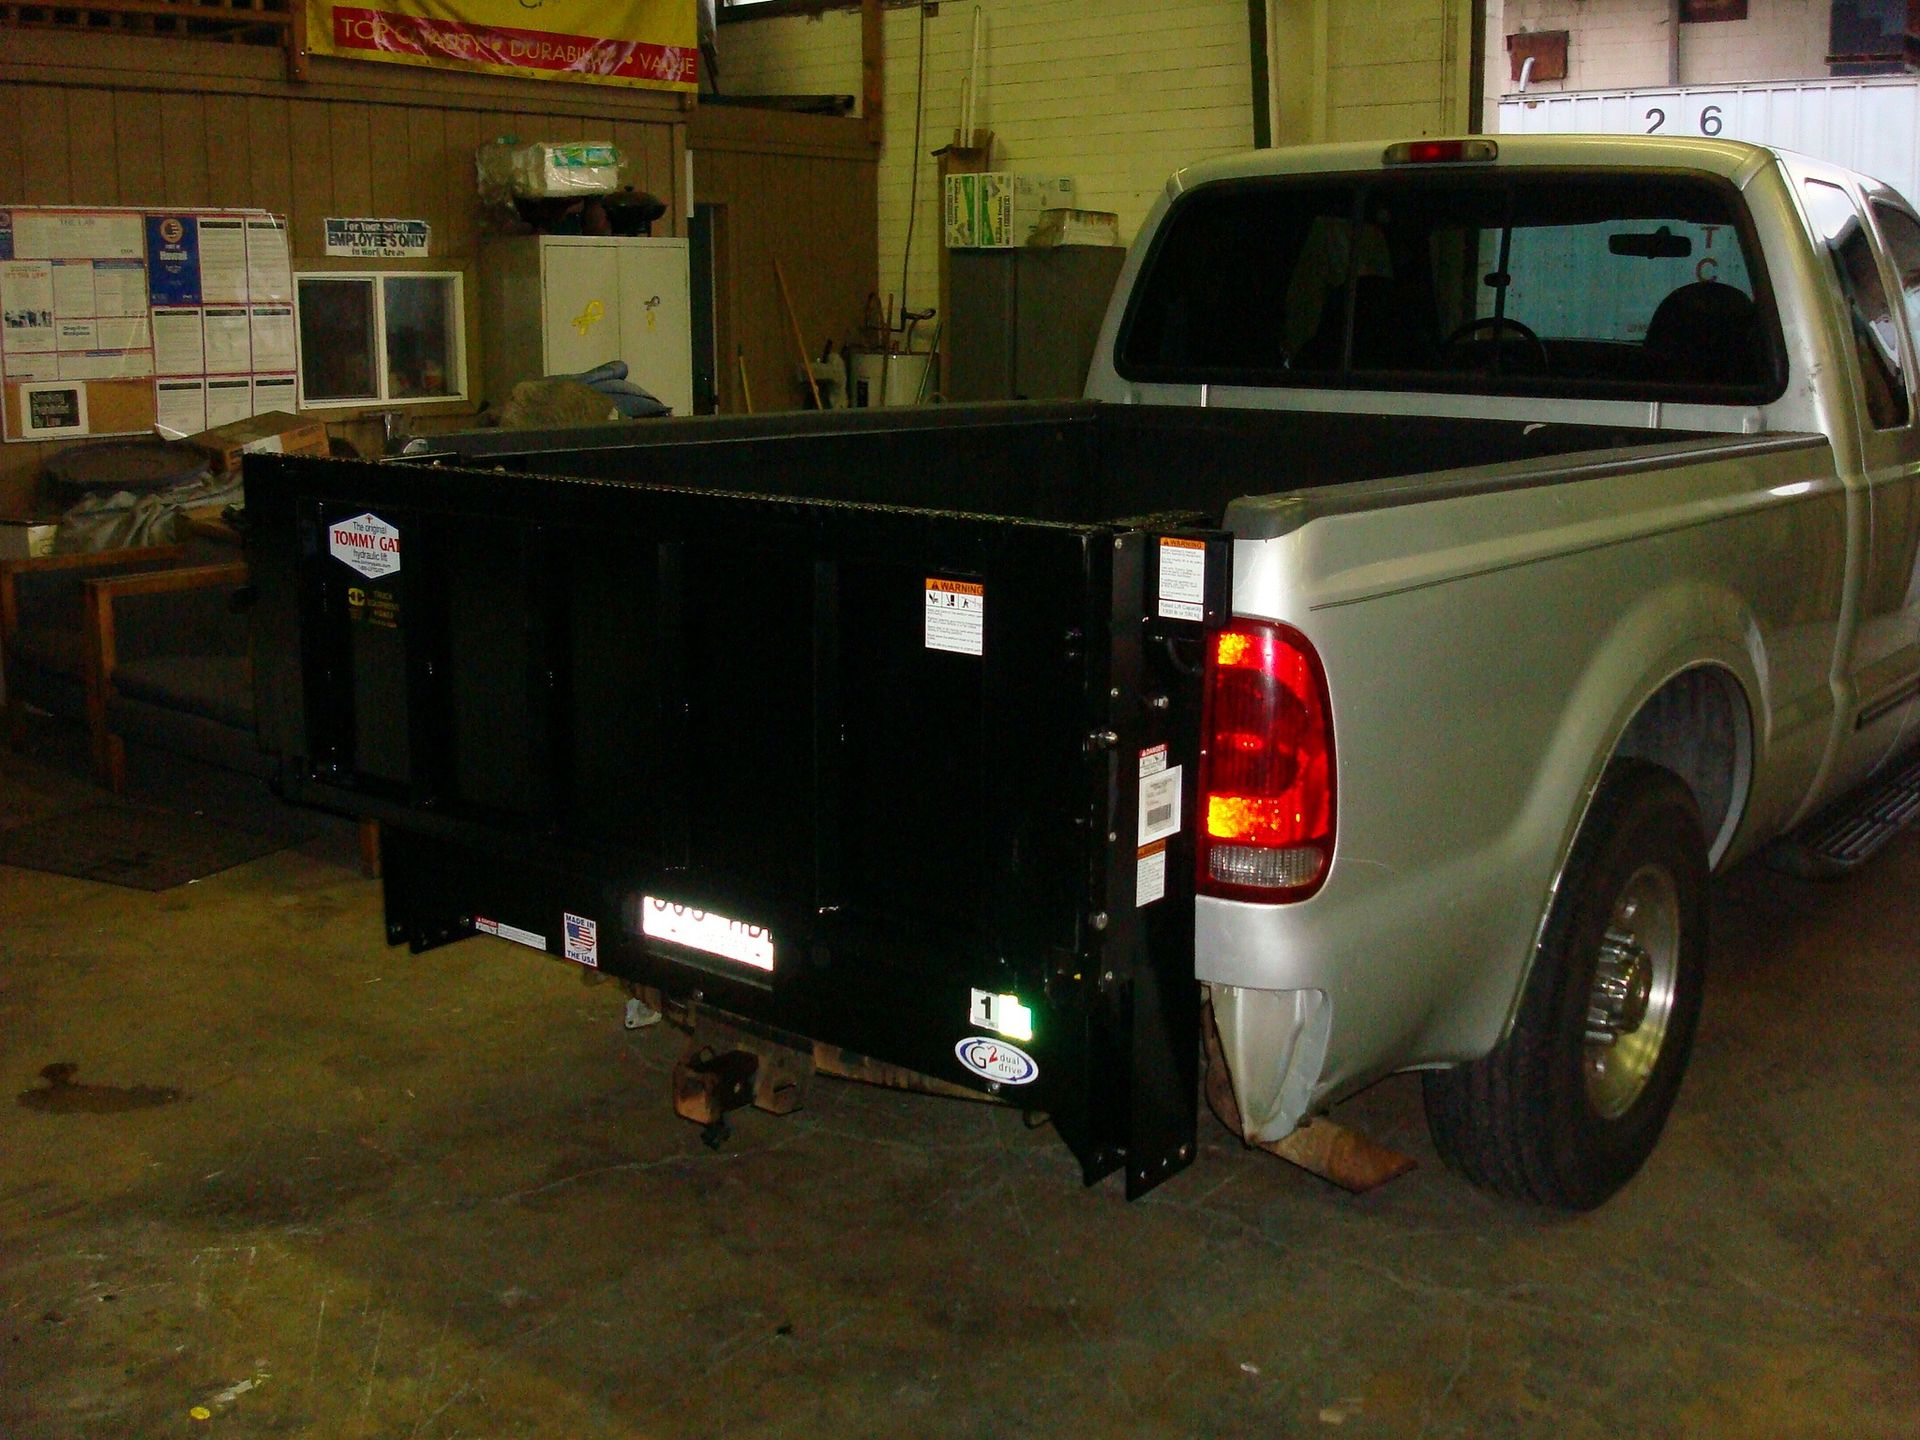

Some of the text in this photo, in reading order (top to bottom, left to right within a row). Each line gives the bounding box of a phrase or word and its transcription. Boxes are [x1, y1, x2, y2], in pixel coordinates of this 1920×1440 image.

[340, 18, 388, 41] TOP
[510, 38, 616, 69] DURABIL
[640, 53, 695, 75] VALUE
[1645, 105, 1723, 137] 2 6
[344, 220, 359, 231] For
[383, 221, 410, 233] Safety
[400, 233, 427, 248] ONLY
[1700, 225, 1720, 249] T
[1695, 257, 1718, 282] C
[352, 521, 387, 535] The original
[334, 530, 401, 553] TOMMY GAT
[1170, 540, 1202, 549] WARNING
[352, 548, 388, 562] hydraulic lift
[940, 580, 984, 595] WARNING
[565, 914, 594, 929] MADE IN
[567, 950, 596, 965] THE USA
[980, 996, 991, 1020] 1
[1000, 1053, 1020, 1065] dual
[998, 1063, 1022, 1075] drive
